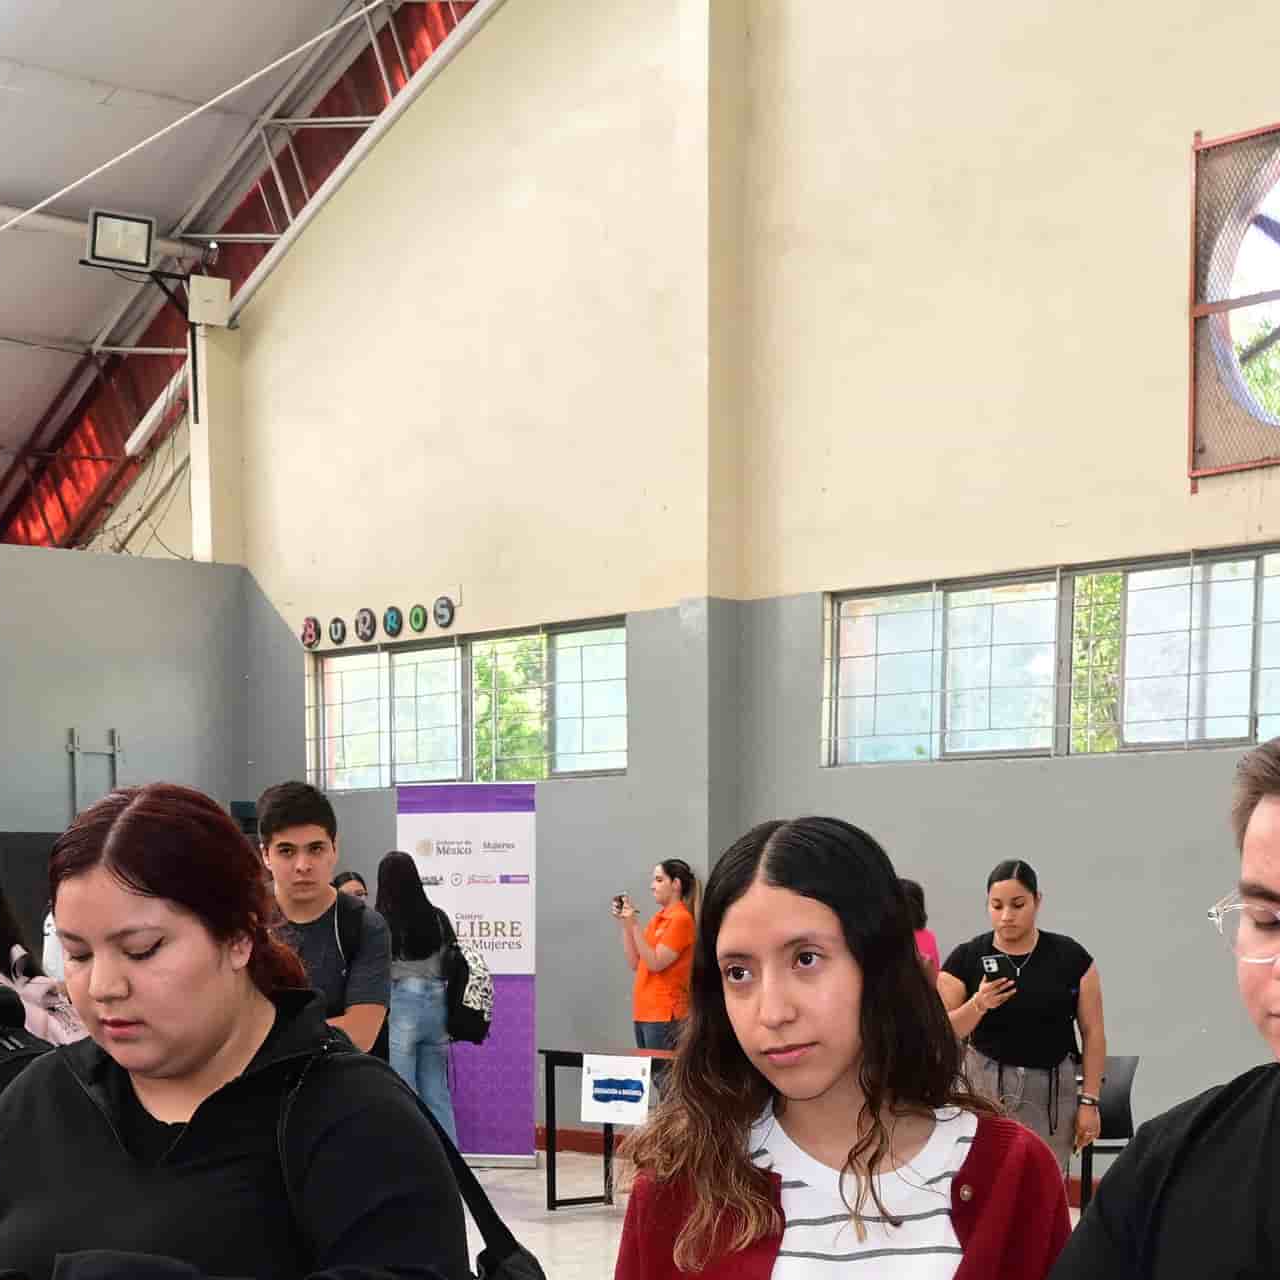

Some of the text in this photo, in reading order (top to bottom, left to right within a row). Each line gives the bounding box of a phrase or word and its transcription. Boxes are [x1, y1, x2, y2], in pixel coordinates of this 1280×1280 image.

[303, 598, 453, 648] BURROS
[436, 846, 472, 856] México
[456, 921, 522, 937] LIBRE
